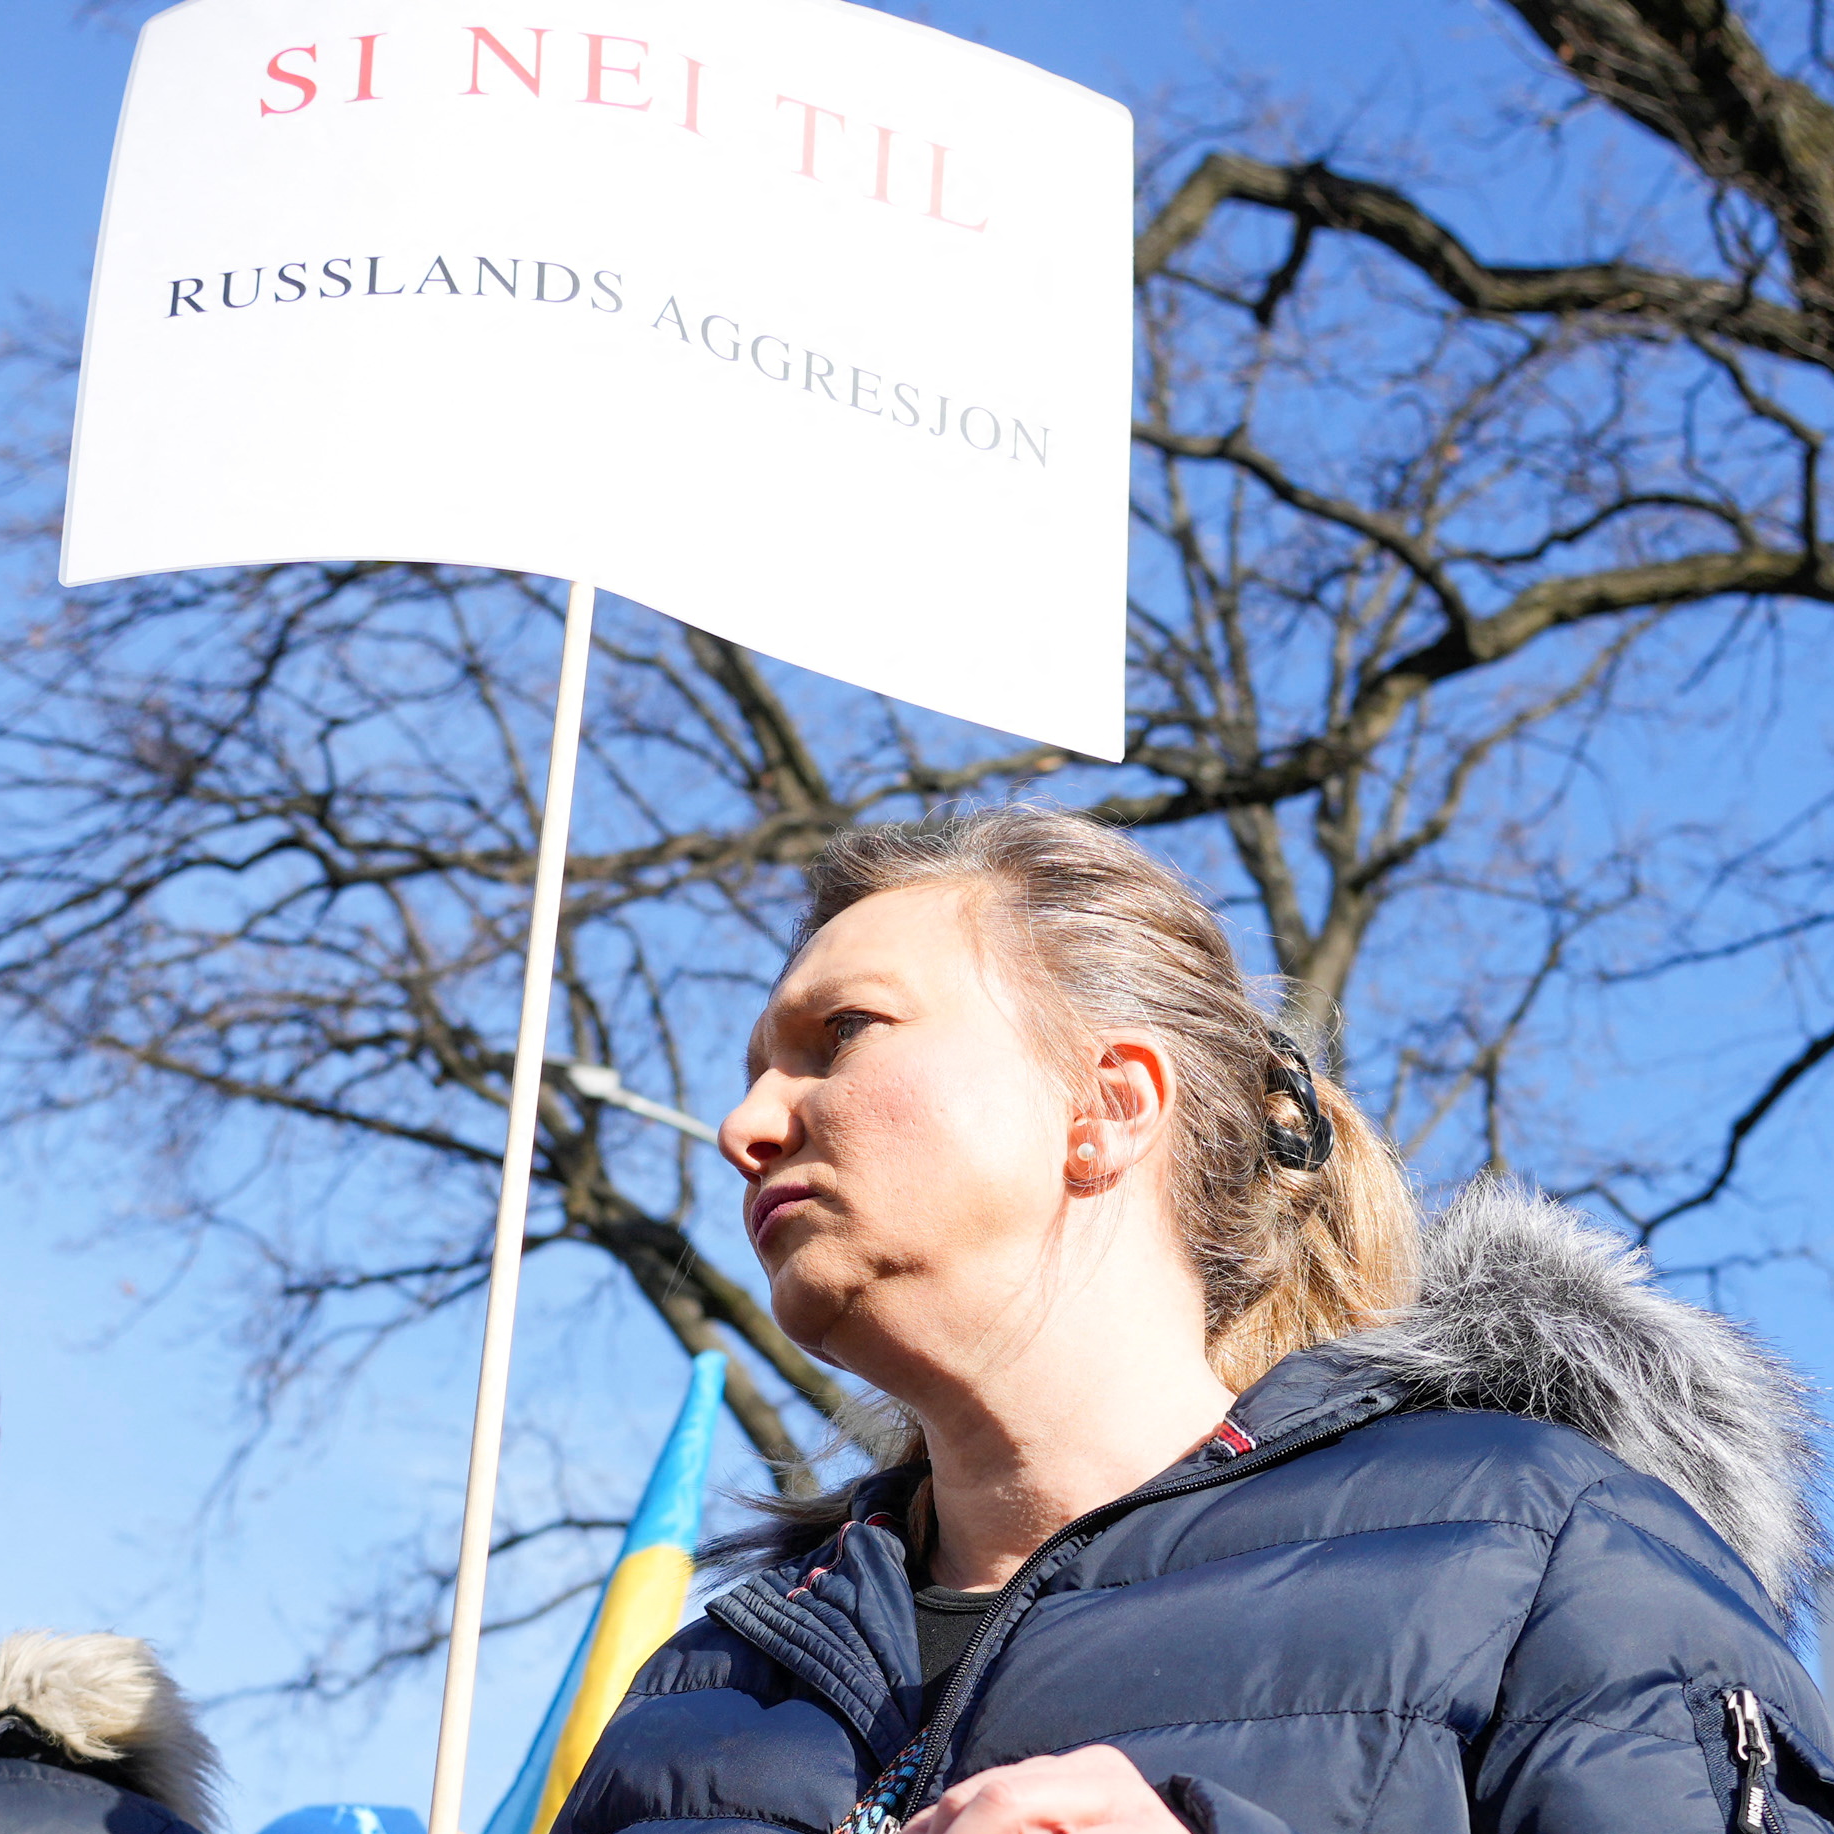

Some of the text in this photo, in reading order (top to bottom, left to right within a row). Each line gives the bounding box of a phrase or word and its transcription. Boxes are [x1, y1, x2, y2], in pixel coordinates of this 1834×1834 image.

[259, 25, 989, 234] SI NEI TIL
[166, 254, 1051, 468] RUSSLANDS AGGRESJON
